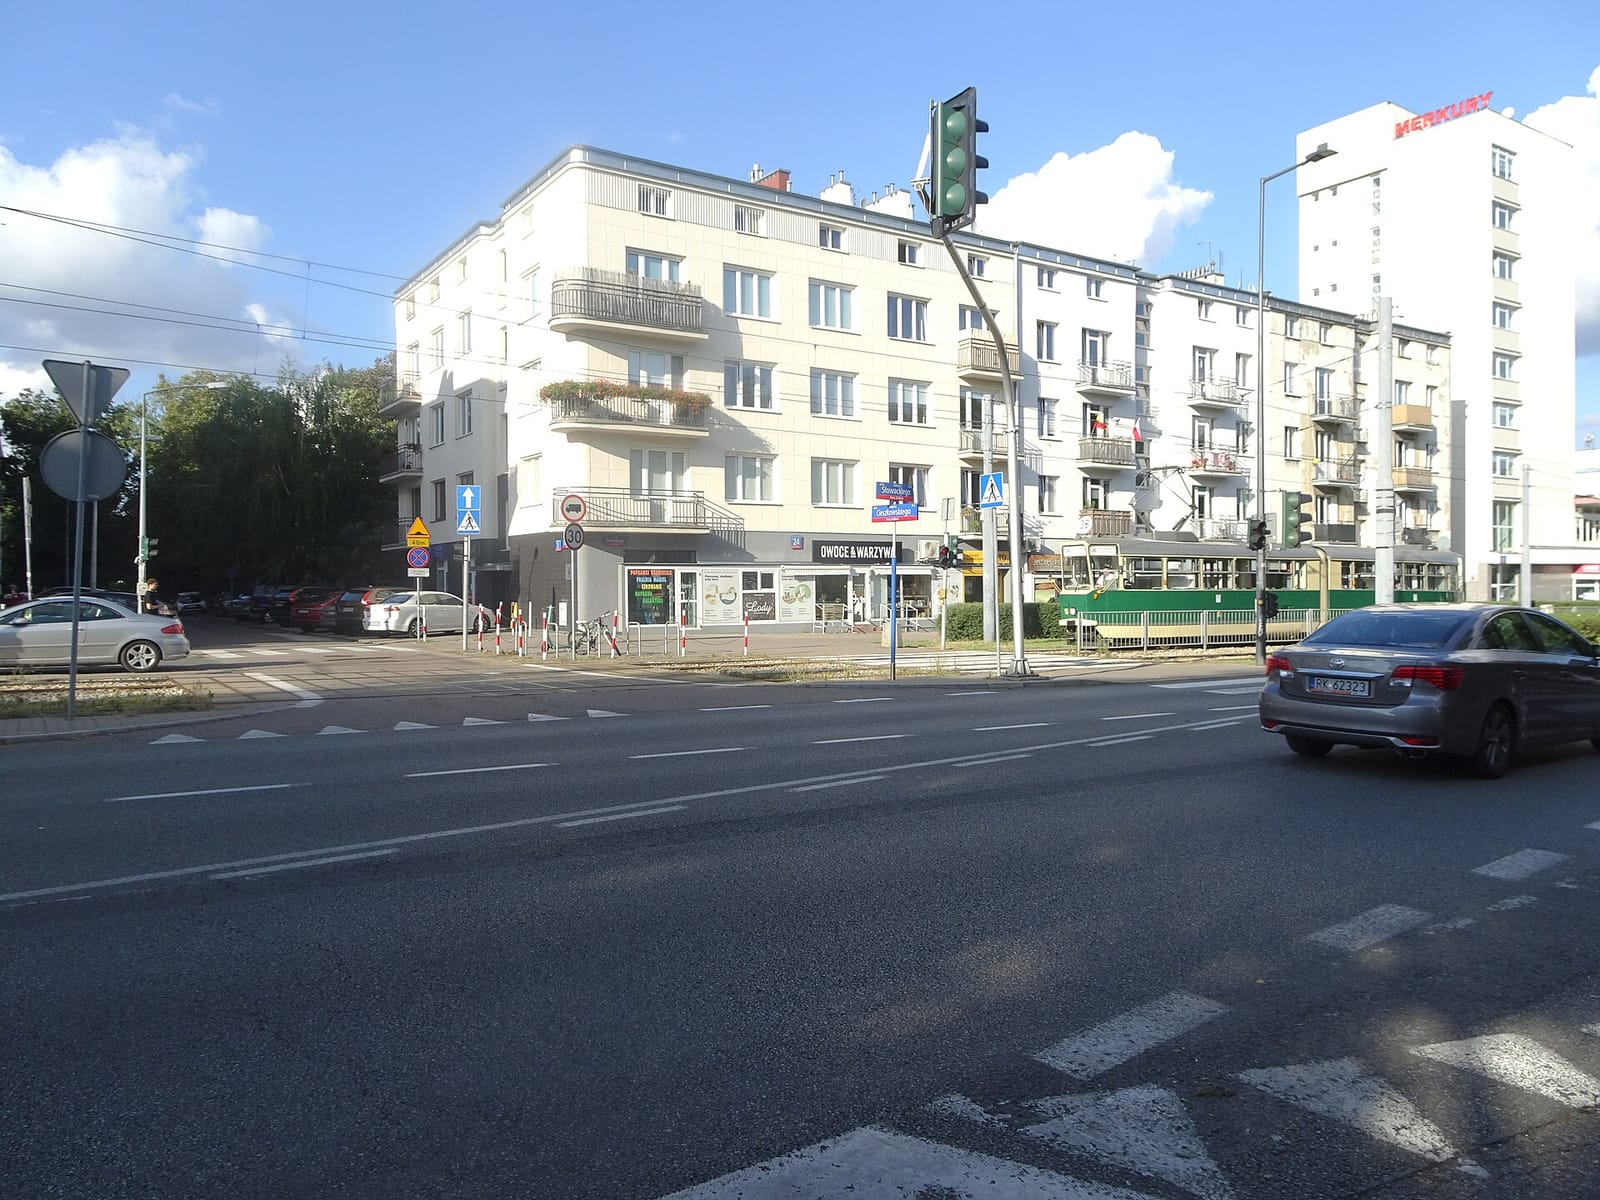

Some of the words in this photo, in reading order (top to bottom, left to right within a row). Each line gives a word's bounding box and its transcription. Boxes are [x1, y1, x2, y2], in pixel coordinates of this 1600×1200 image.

[1394, 91, 1493, 139] MERKURY
[567, 529, 582, 544] 30
[792, 538, 801, 547] 24
[821, 545, 849, 558] OWOCE
[850, 545, 857, 558] &
[745, 600, 773, 615] Lody
[1316, 678, 1329, 690] RK
[1332, 680, 1366, 692] 62323
